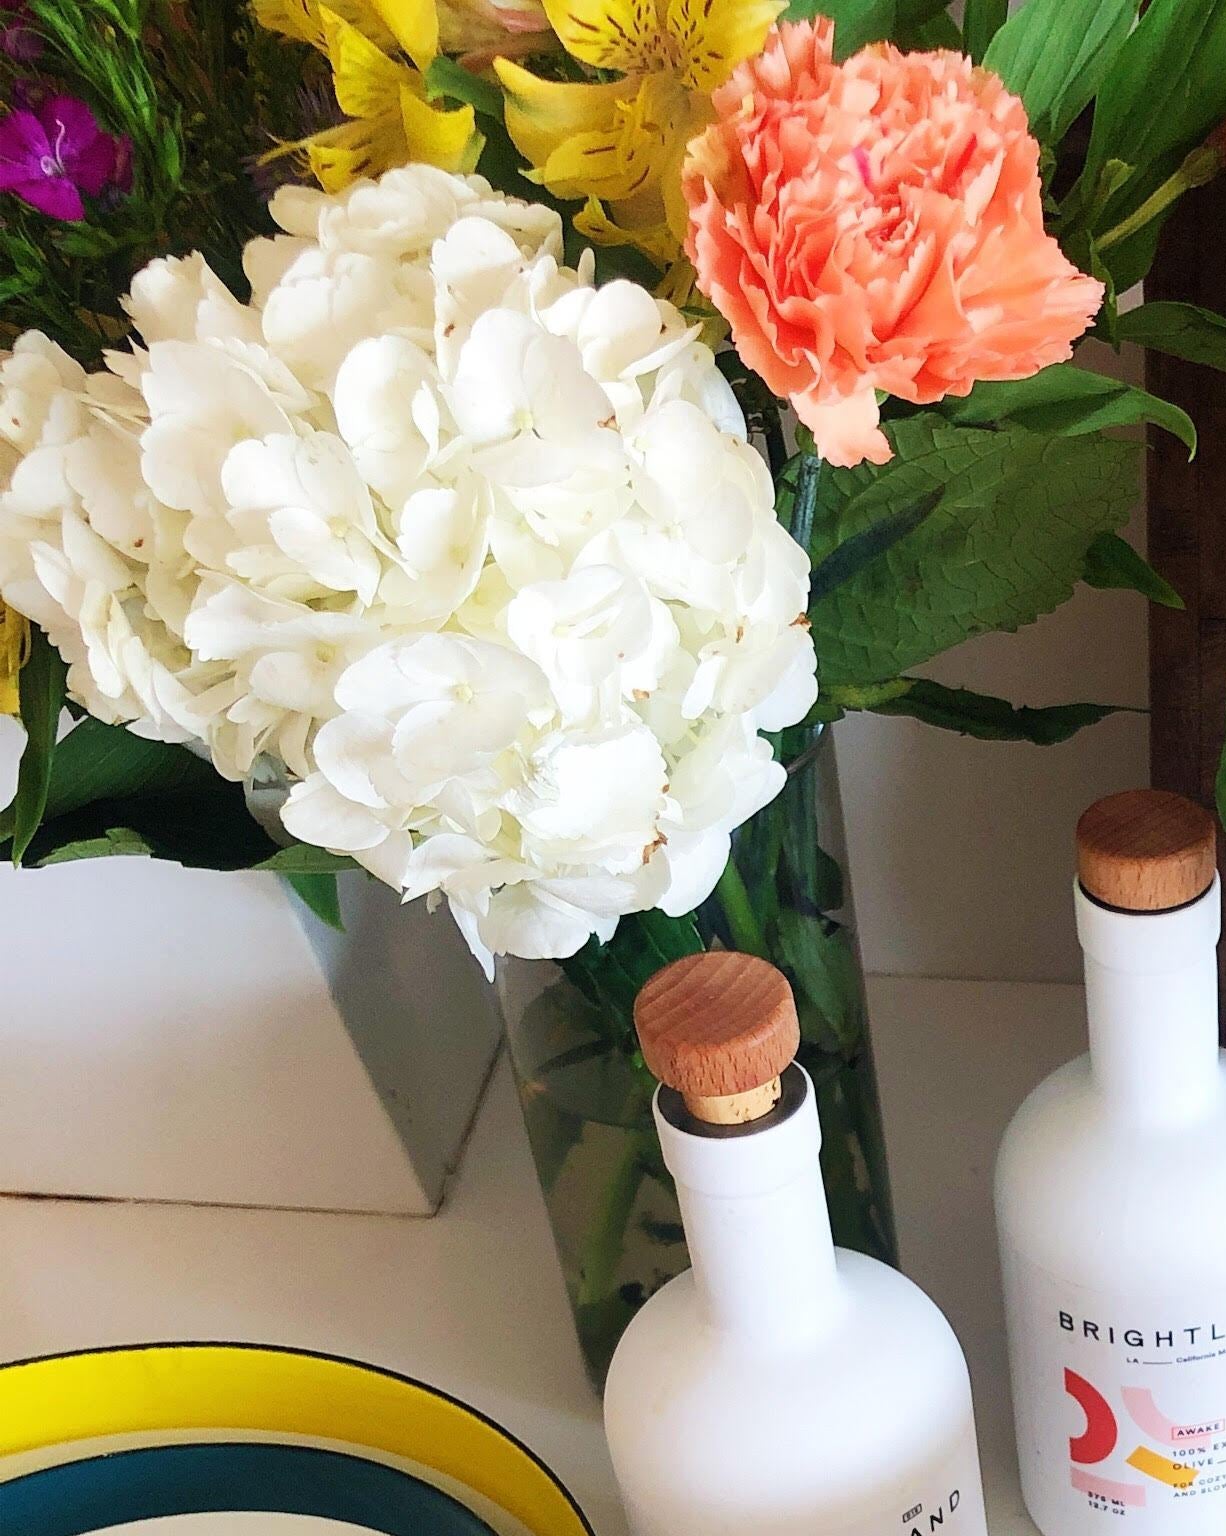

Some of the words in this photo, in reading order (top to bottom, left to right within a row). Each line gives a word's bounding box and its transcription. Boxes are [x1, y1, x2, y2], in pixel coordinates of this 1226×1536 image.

[1176, 1352, 1216, 1364] California
[1176, 1422, 1221, 1437] AWAKE
[1172, 1446, 1207, 1457] 100%
[1172, 1457, 1215, 1471] OLIVE
[1173, 1489, 1197, 1498] AND
[1112, 1508, 1126, 1516] OZ
